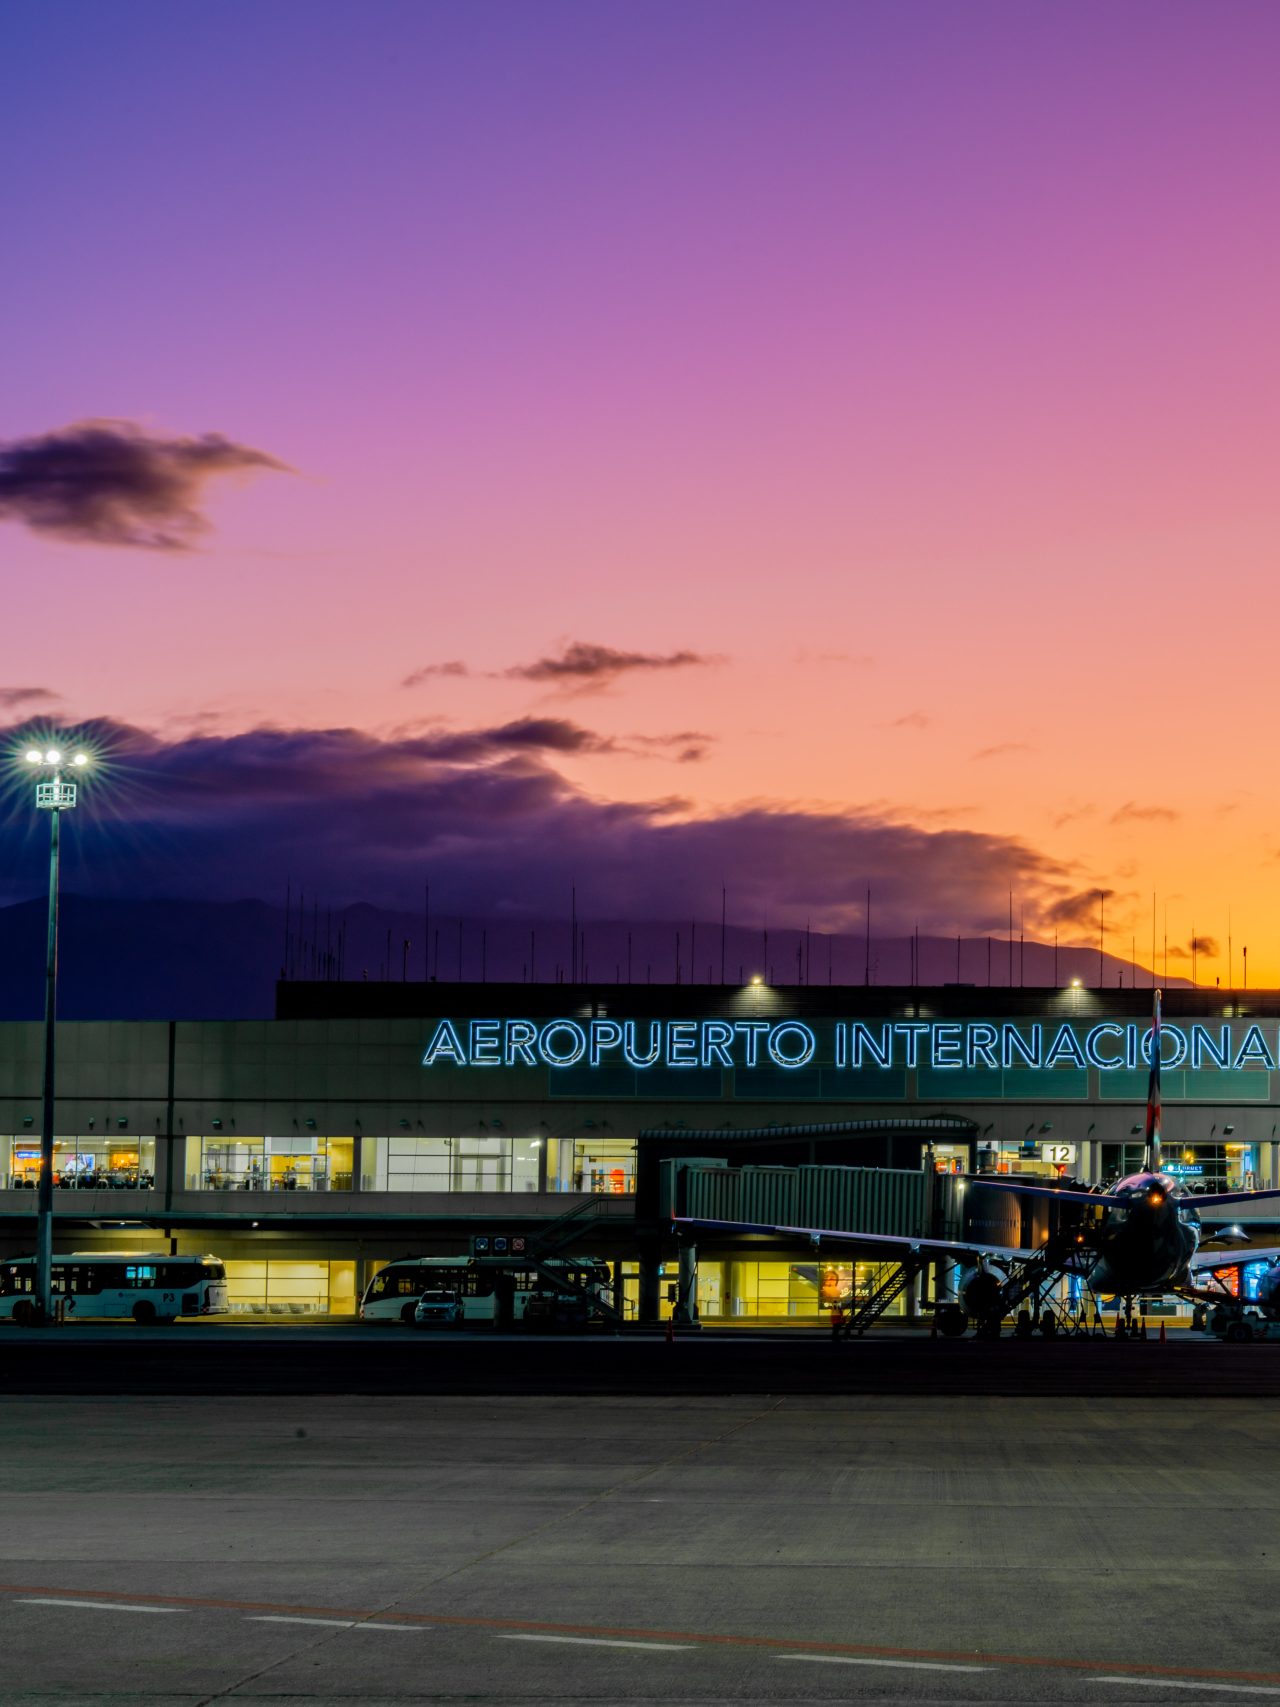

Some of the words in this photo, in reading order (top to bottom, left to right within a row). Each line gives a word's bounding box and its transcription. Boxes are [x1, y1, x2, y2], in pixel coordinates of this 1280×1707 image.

[423, 1021, 816, 1069] AEROPUERTO
[1050, 1146, 1069, 1161] 12
[162, 1293, 175, 1303] P3
